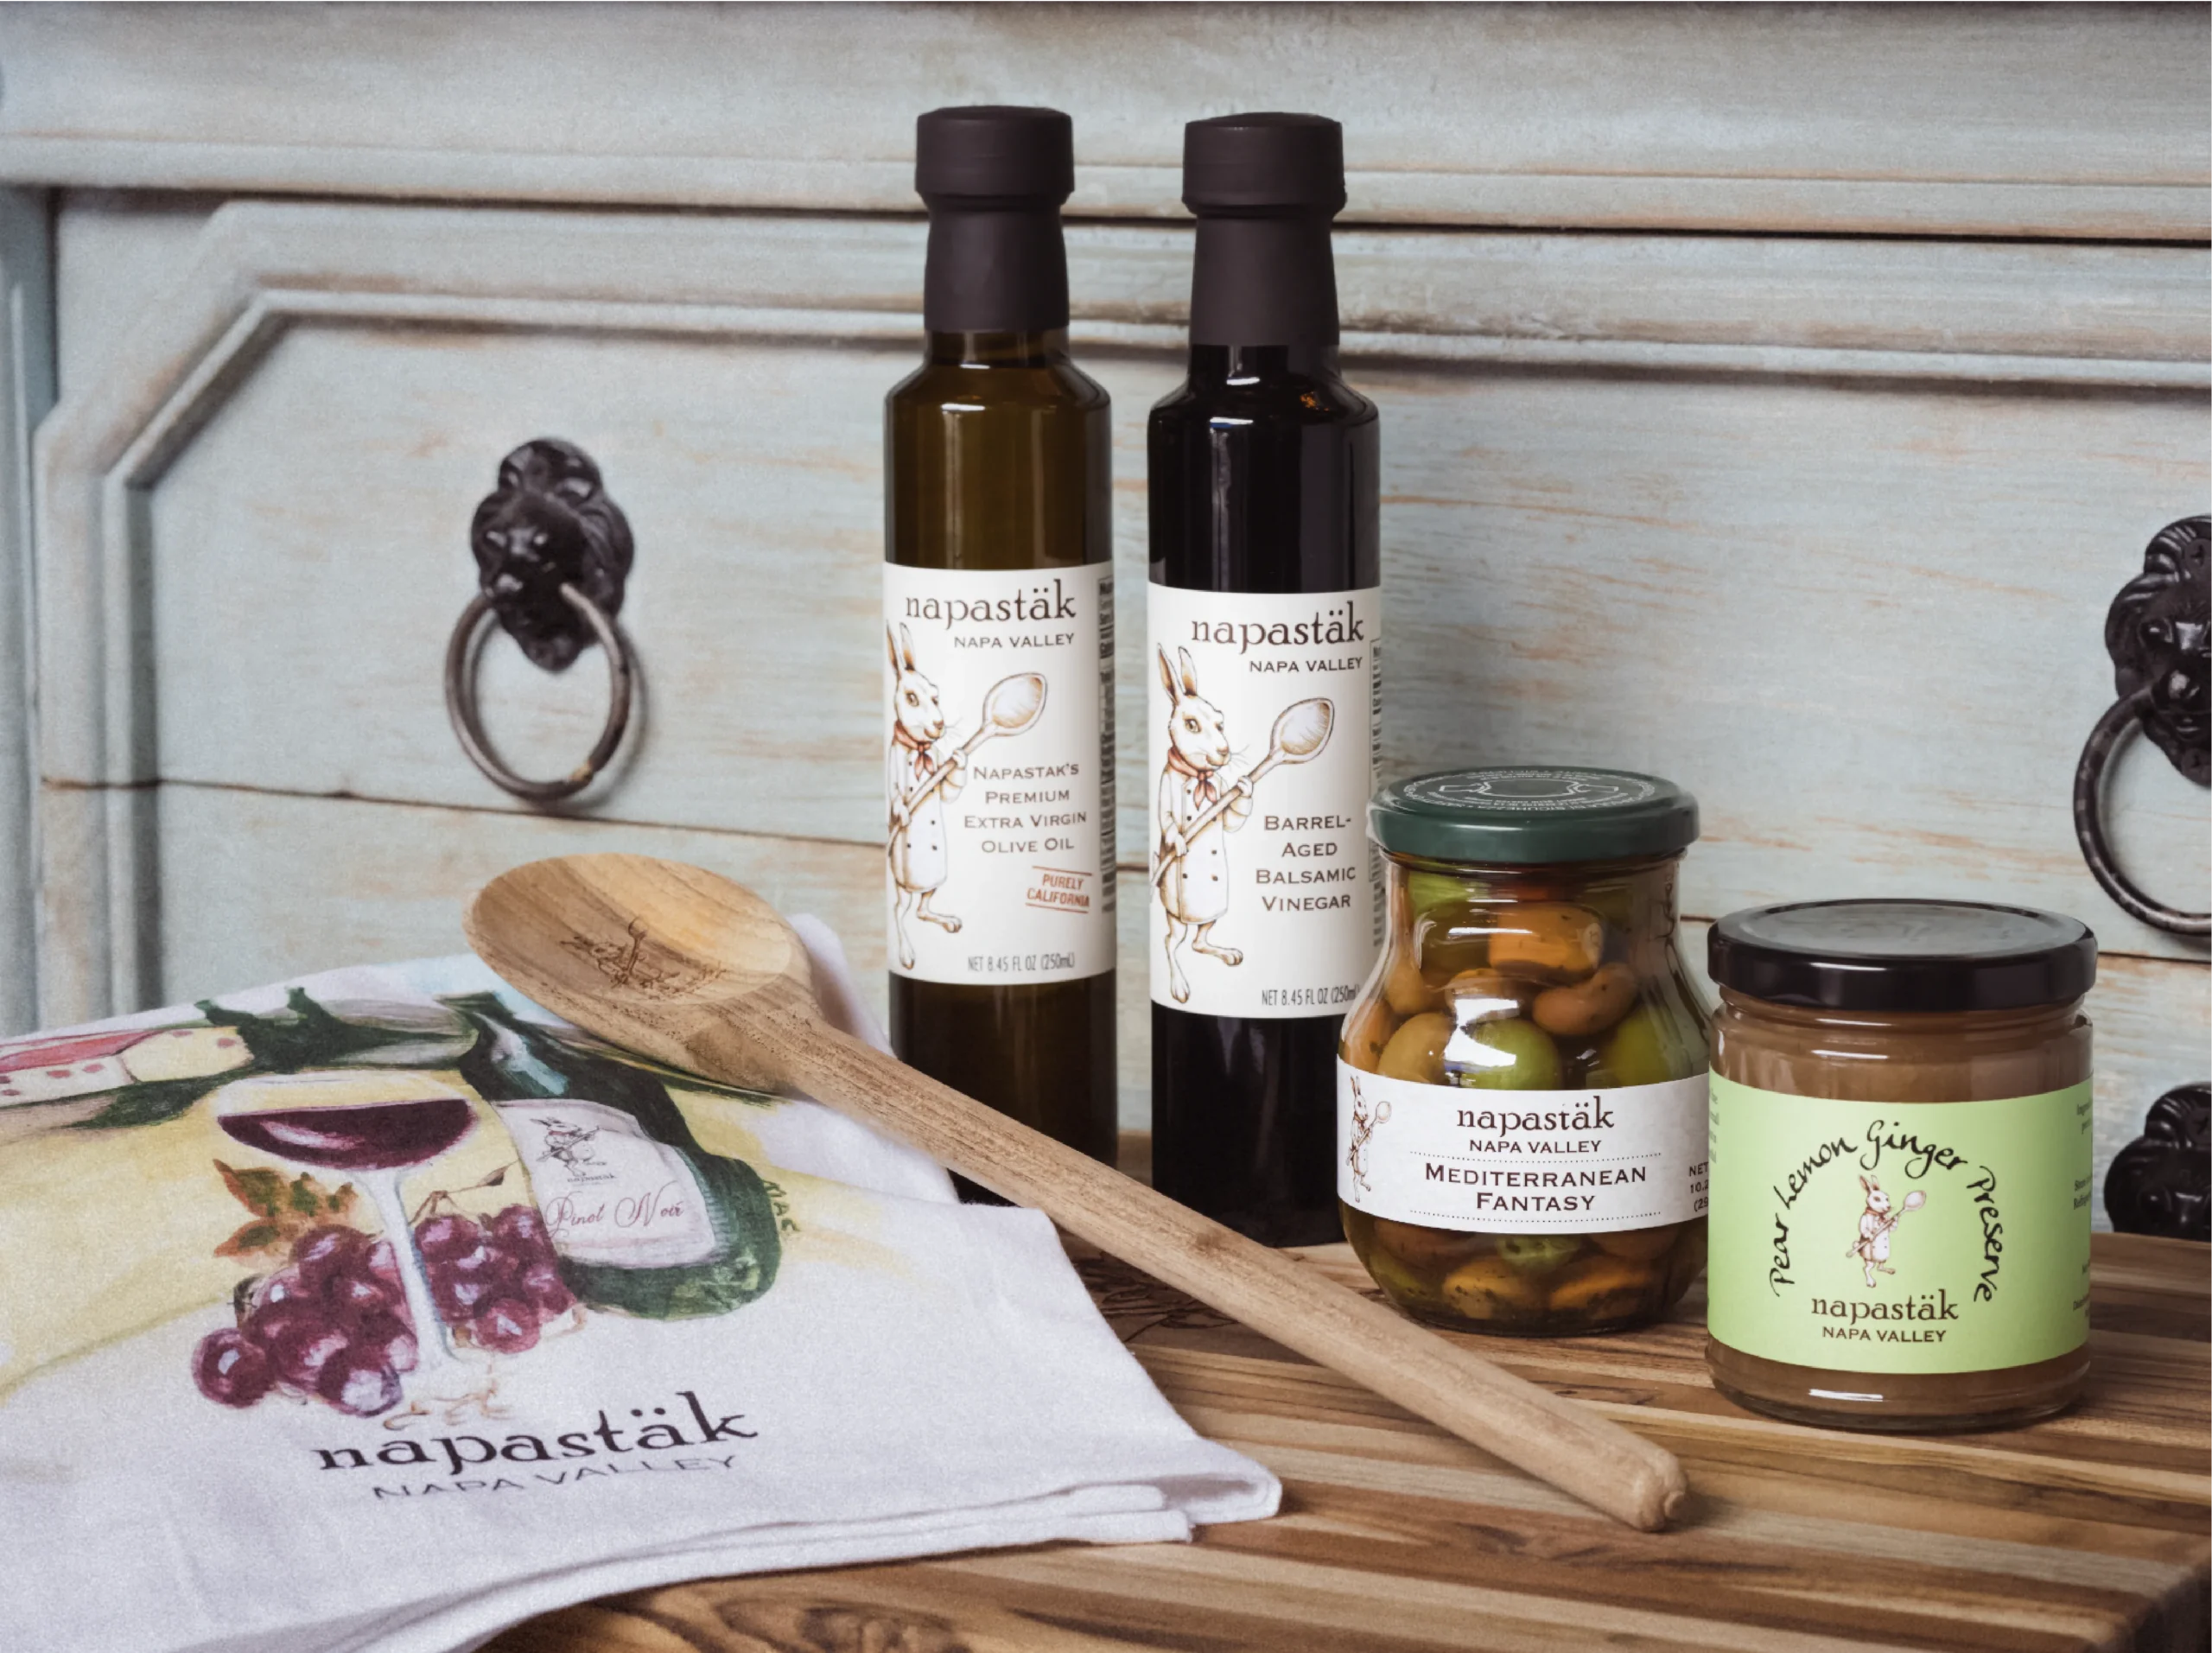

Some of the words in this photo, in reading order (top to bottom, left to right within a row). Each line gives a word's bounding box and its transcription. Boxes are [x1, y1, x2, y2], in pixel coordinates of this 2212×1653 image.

[906, 578, 1077, 630] napastäk
[1191, 601, 1364, 655] napastäk
[954, 636, 1002, 648] NAPA
[1009, 633, 1075, 647] VALLEY
[1250, 660, 1300, 672] NAPA
[1306, 657, 1363, 671] VALLEY
[974, 763, 1079, 780] NAPASTAK'S
[985, 790, 1070, 804] PREMIUM
[964, 816, 1023, 829] EXTRA
[1030, 811, 1087, 827] VIRGIN
[1264, 816, 1351, 831] BARREL-
[982, 840, 1038, 853] OLIVE
[1045, 837, 1075, 850] OIL
[1281, 842, 1338, 858] AGED
[1042, 874, 1084, 890] PURELY
[1255, 867, 1357, 885] BALSAMIC
[1027, 888, 1090, 907] CALIFORNIA
[1262, 894, 1351, 912] VINEGAR
[967, 956, 983, 972] NET
[1012, 956, 1021, 971] FL
[1025, 955, 1037, 970] OZ
[1262, 989, 1278, 1006] NET
[1281, 989, 1303, 1006] 8.45
[1306, 989, 1315, 1005] FL
[1318, 988, 1328, 1004] OZ
[1457, 1096, 1615, 1137] napastäk
[1470, 1139, 1523, 1154] NAPA
[1528, 1139, 1602, 1154] VALLEY
[1859, 1119, 1968, 1179] Ginger
[1426, 1162, 1647, 1187] MEDITERRANEAN
[1773, 1135, 1858, 1210] Lemon
[544, 1190, 605, 1238] Pinot
[614, 1179, 686, 1229] Noir
[1476, 1192, 1597, 1211] FANTASY
[1966, 1165, 2005, 1302] Preserve
[1769, 1212, 1796, 1297] Pear
[1811, 1288, 1959, 1326] napastäk
[1822, 1326, 1872, 1341] NAPA
[1877, 1329, 1947, 1343] VALLEY
[312, 1390, 759, 1476] napastäk
[372, 1478, 525, 1499] NAPA
[535, 1454, 736, 1485] VALLEY
